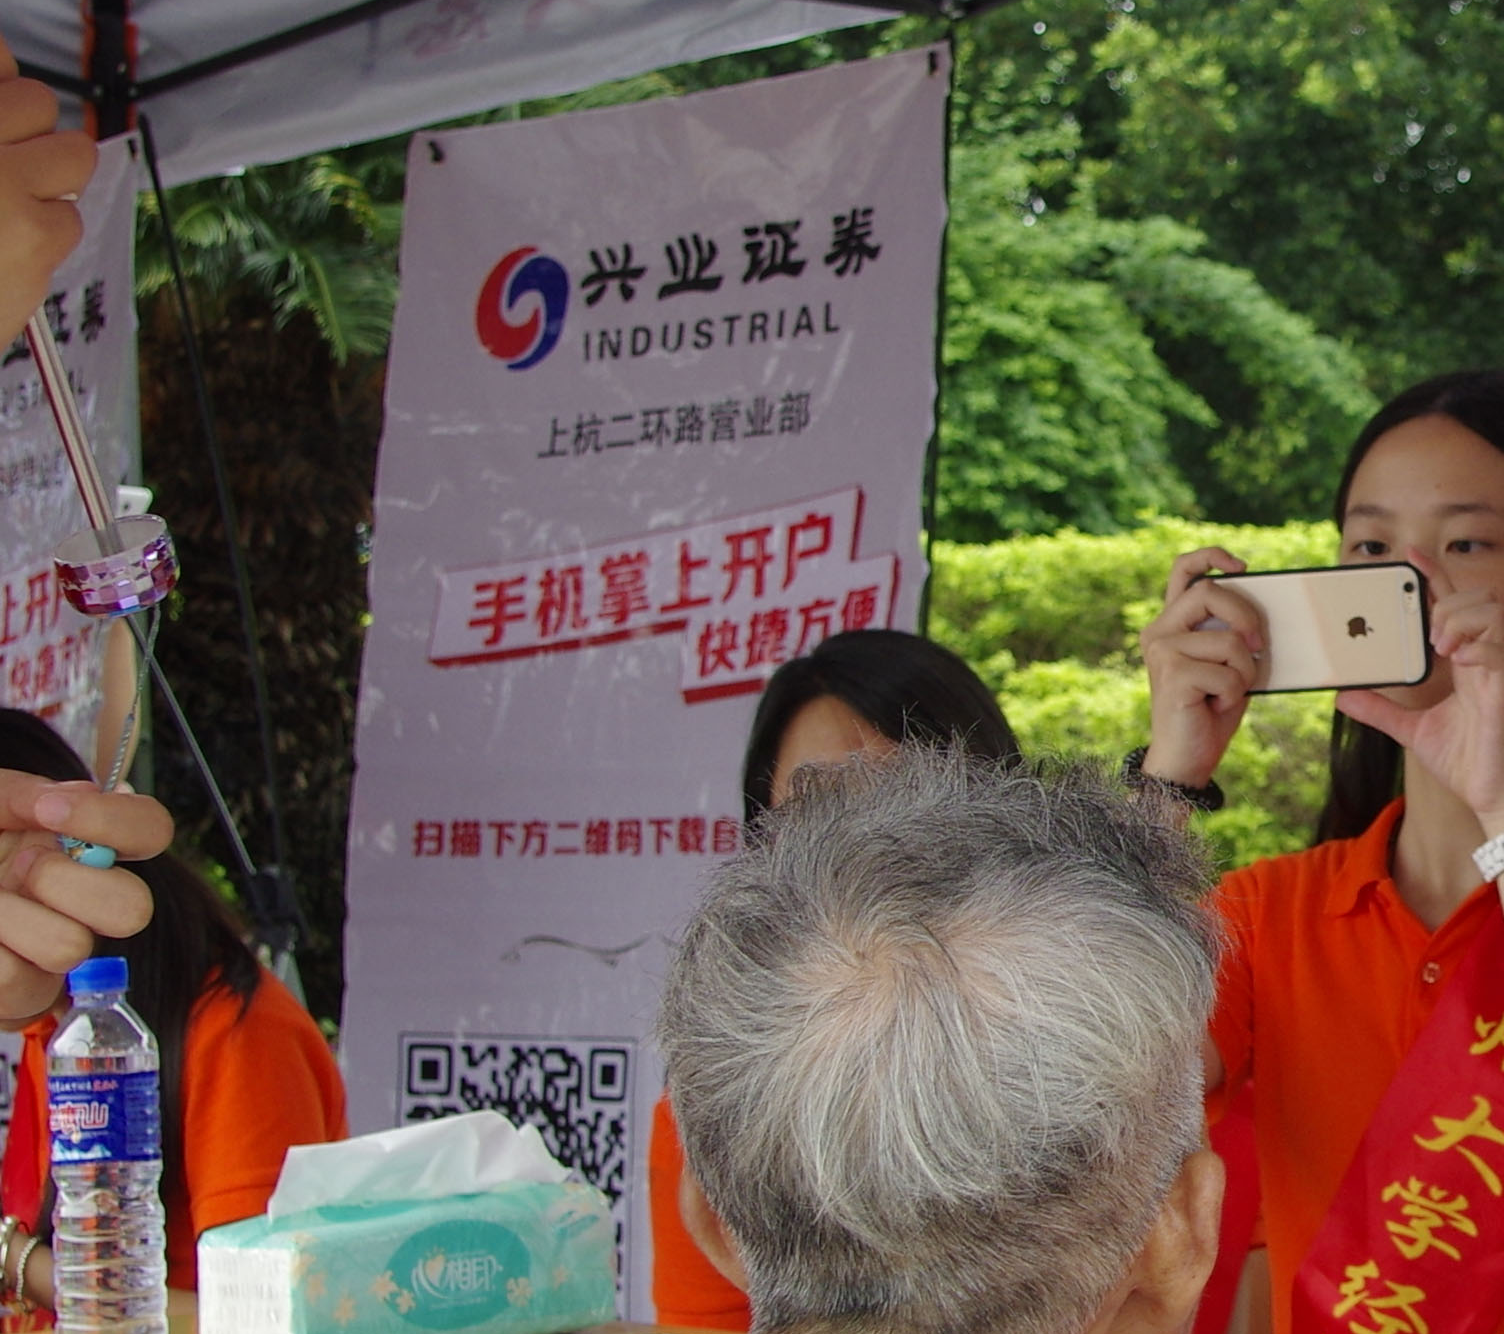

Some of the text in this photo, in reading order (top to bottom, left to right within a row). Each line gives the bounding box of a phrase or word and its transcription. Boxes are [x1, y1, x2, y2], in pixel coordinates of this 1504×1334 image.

[579, 203, 885, 304] 兴业证券
[582, 301, 843, 364] INDUSTRIAL
[536, 391, 813, 460] 上杭二环路营业部
[467, 511, 835, 647] 手机掌上开户
